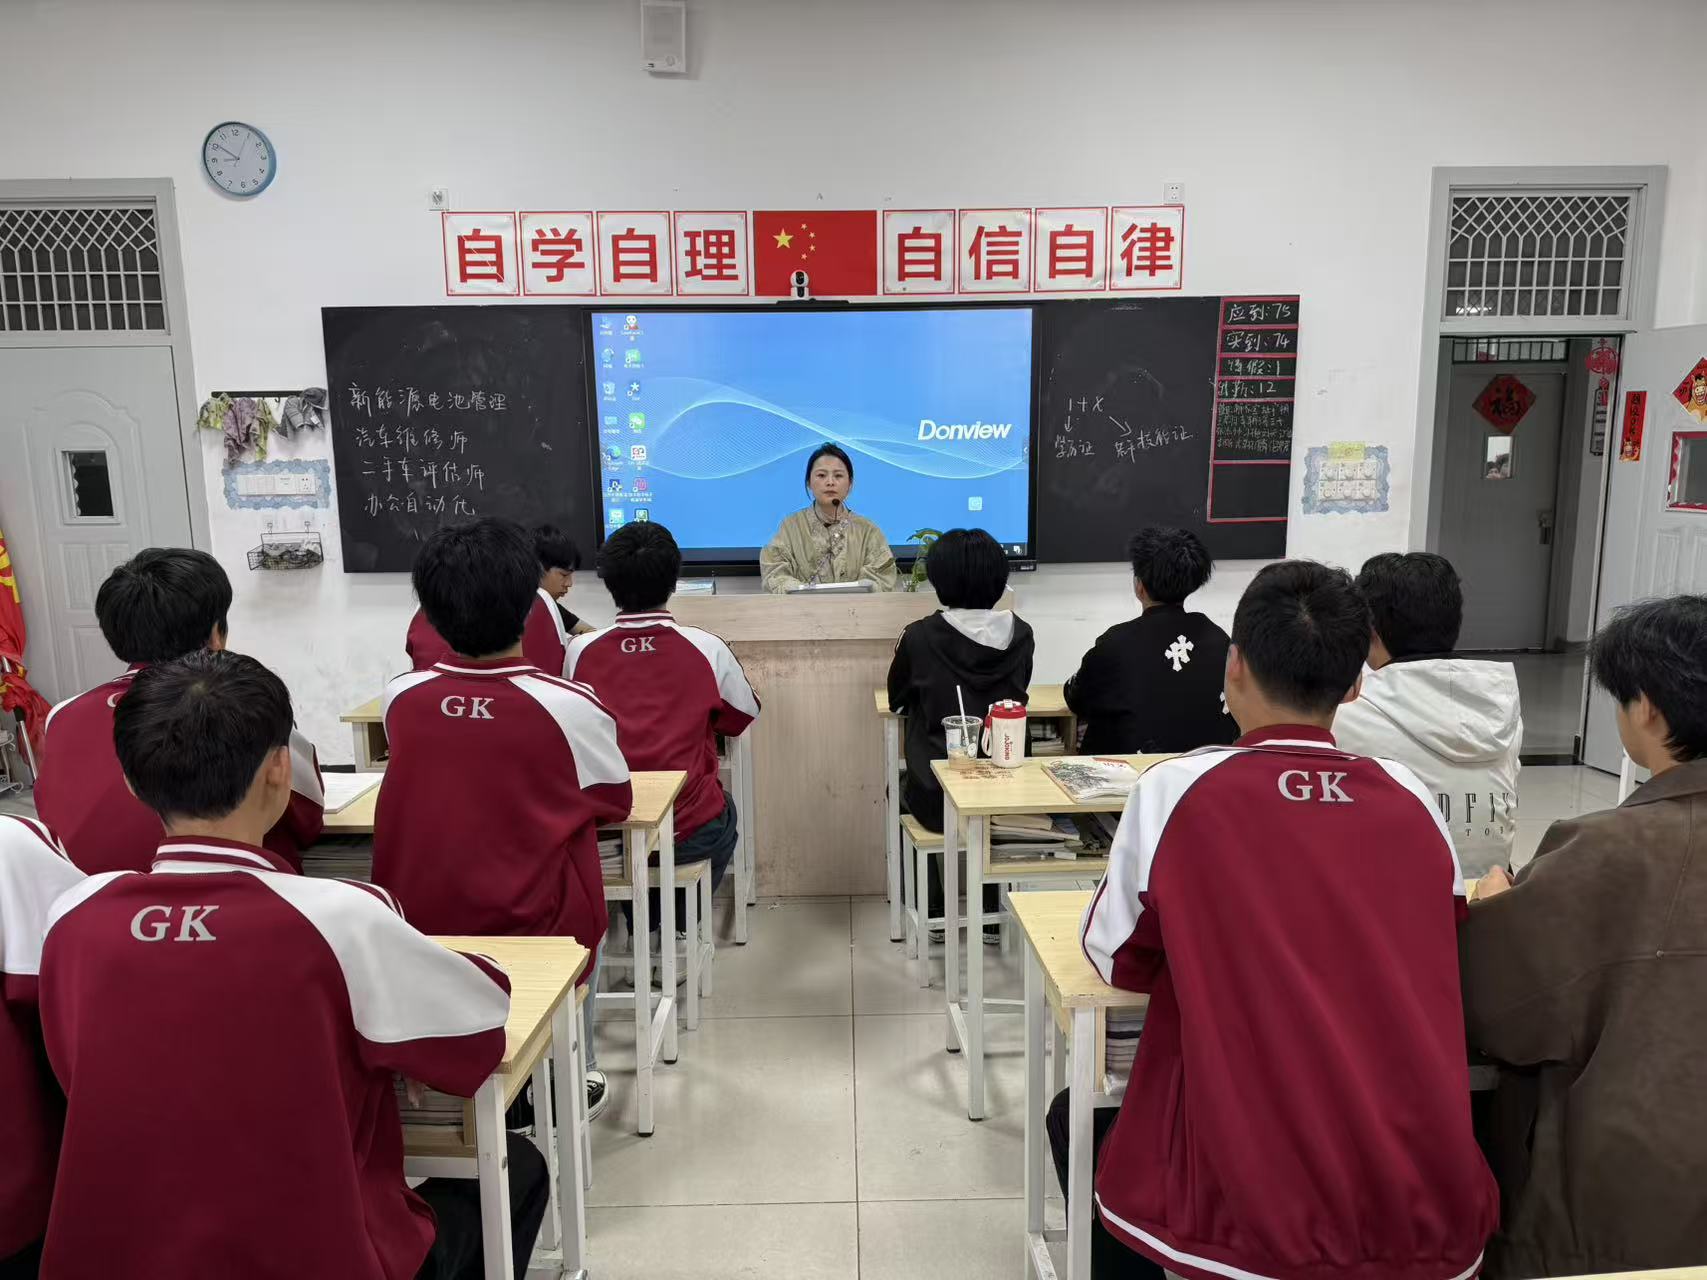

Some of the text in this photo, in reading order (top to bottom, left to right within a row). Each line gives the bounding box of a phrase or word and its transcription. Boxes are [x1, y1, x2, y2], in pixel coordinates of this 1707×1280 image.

[457, 222, 1175, 283] 自学自理 自信自律
[348, 382, 507, 417] 新能源电池管理
[355, 425, 468, 453] 汽车维修师
[918, 419, 1012, 440] Donview
[1055, 434, 1095, 458] 学历证
[362, 456, 486, 490] 二手车评估师
[365, 493, 475, 516] 办公自动化
[620, 636, 657, 653] GK
[440, 695, 495, 719] GK
[1277, 769, 1354, 802] GK
[130, 905, 220, 942] GK
